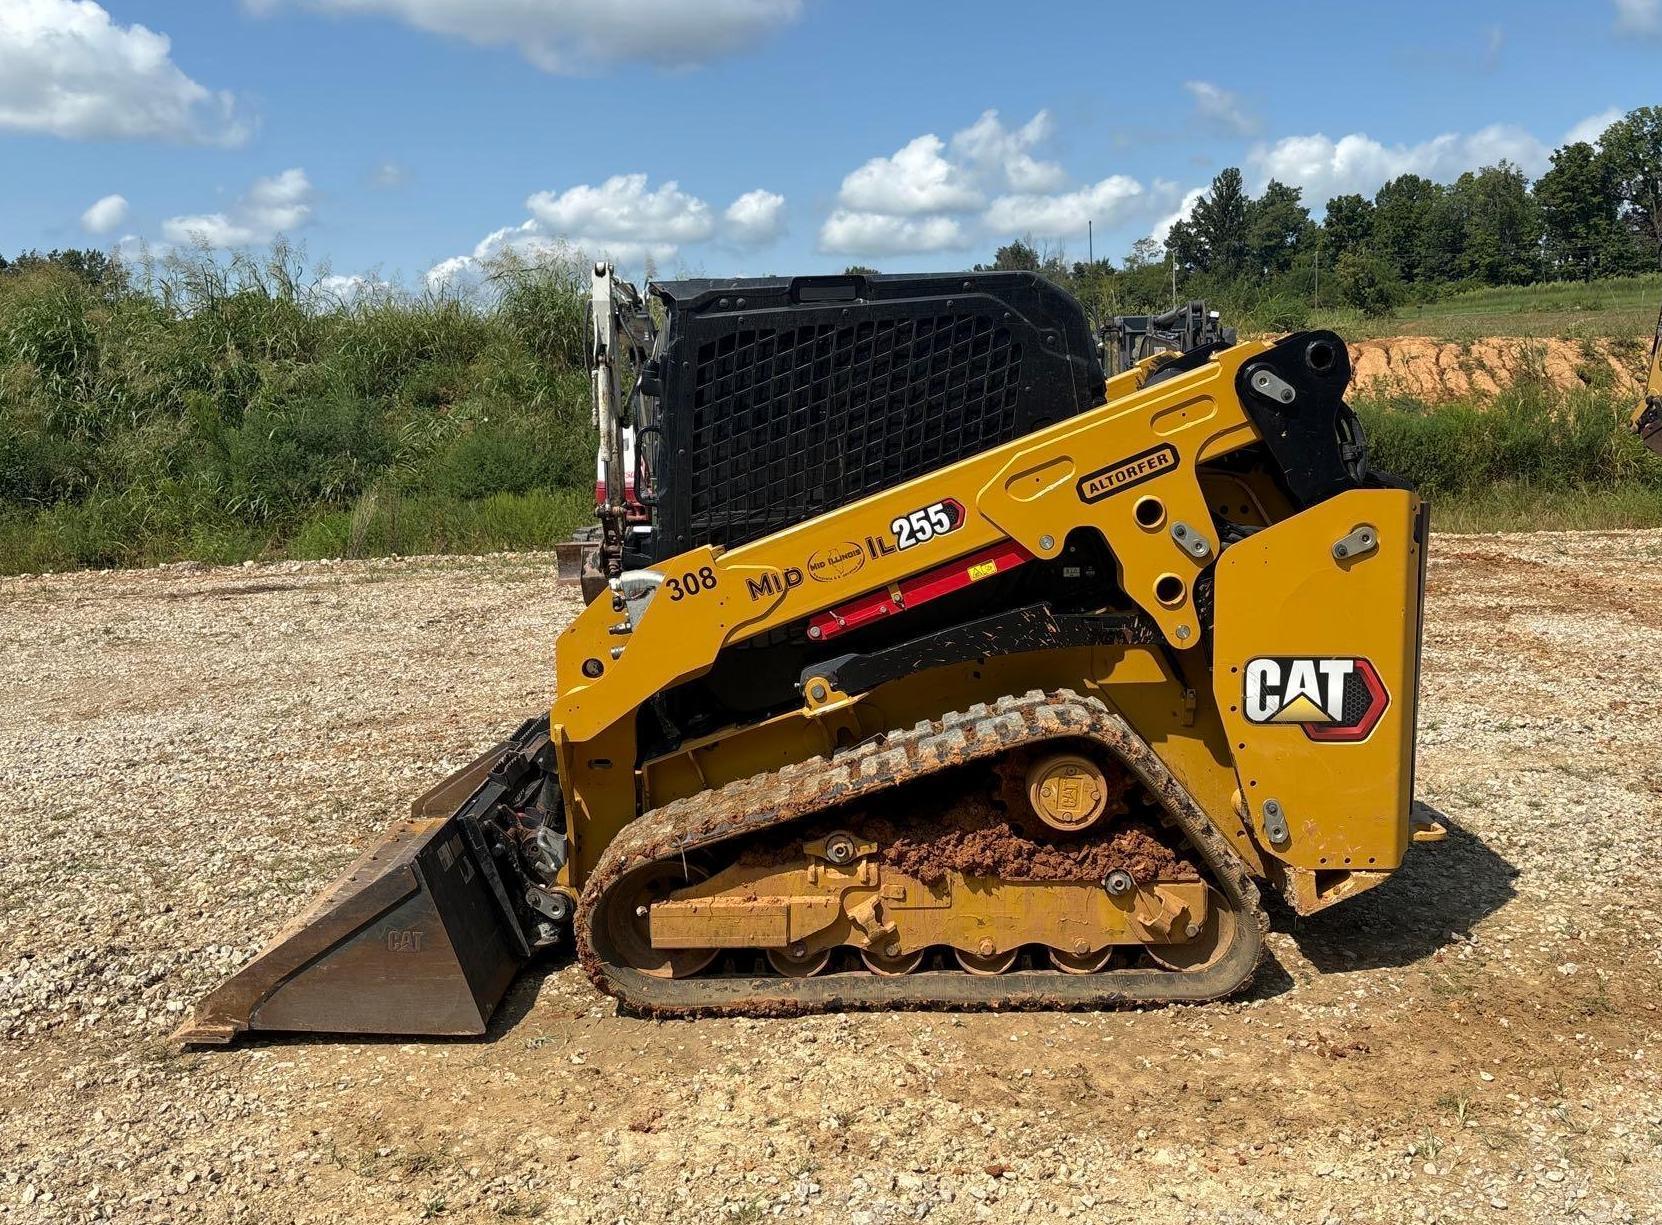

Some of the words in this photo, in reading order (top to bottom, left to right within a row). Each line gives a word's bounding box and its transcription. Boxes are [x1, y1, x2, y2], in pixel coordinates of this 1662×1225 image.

[1089, 453, 1169, 494] ALTORFER
[891, 502, 951, 550] 255
[810, 561, 826, 571] MID
[827, 548, 862, 565] ILLINOIS
[864, 536, 897, 560] IL
[665, 566, 718, 601] 308
[745, 567, 804, 601] MID
[1245, 658, 1354, 722] CAT
[387, 929, 425, 953] CAT
